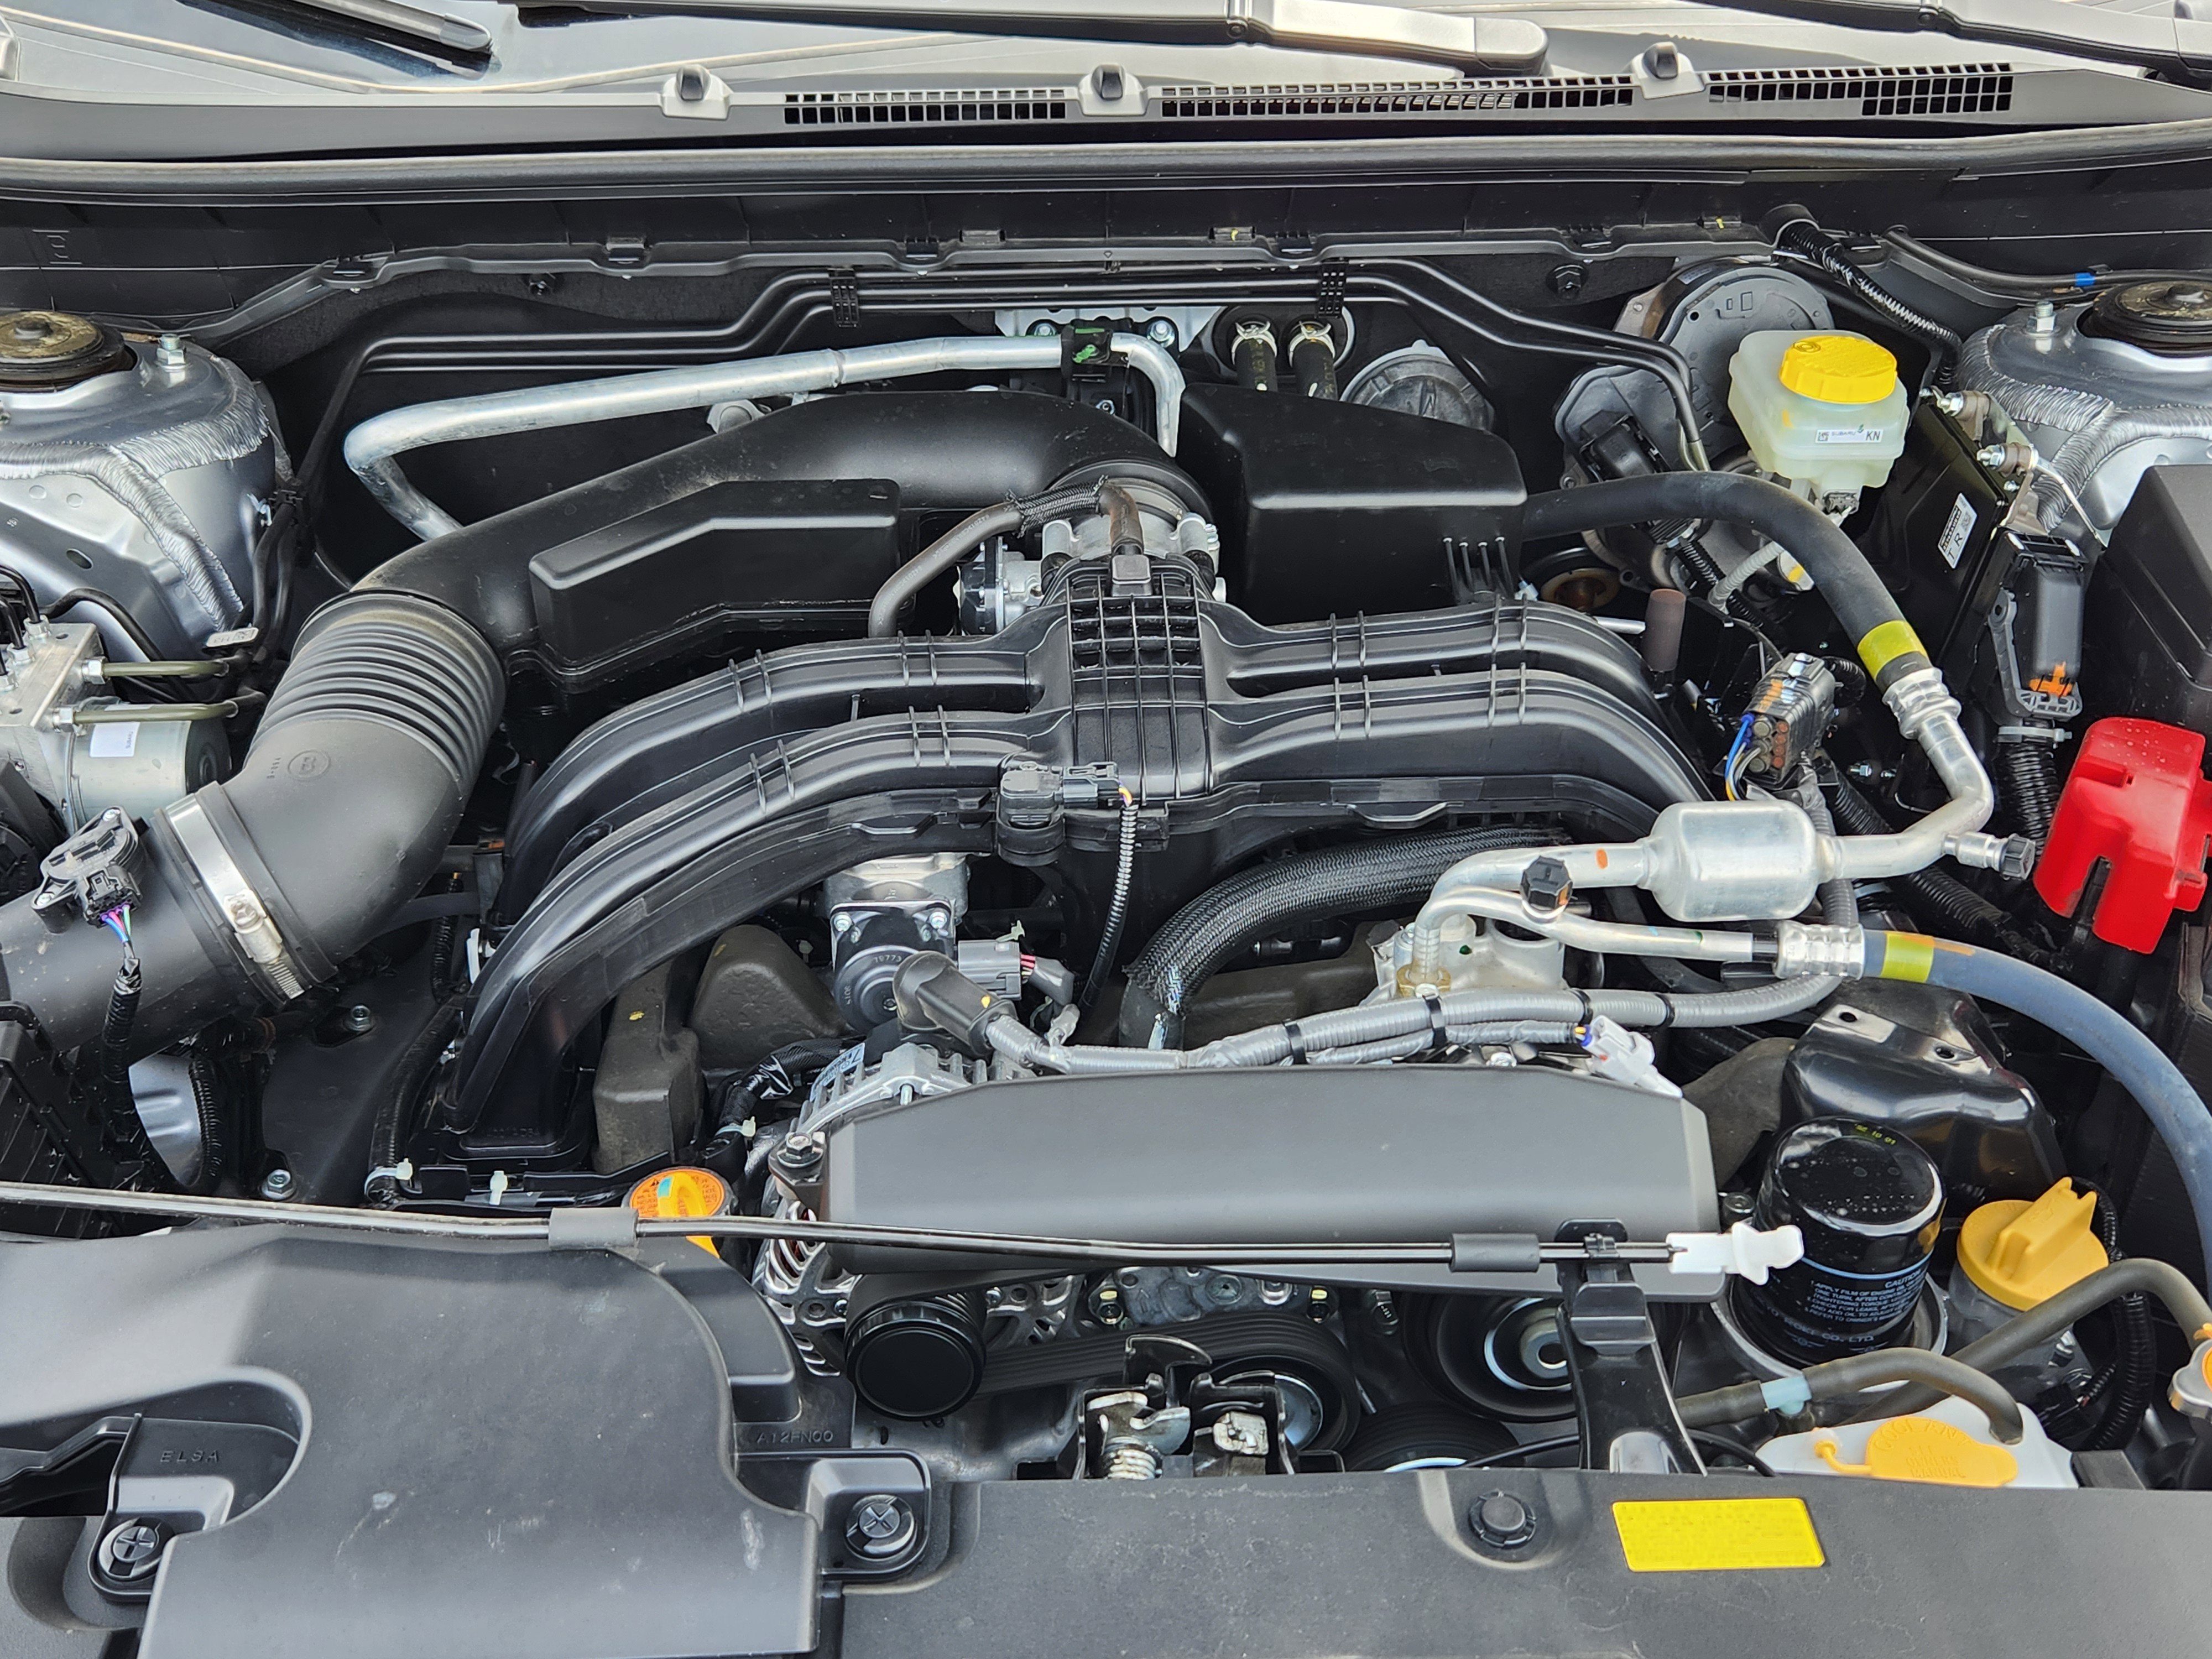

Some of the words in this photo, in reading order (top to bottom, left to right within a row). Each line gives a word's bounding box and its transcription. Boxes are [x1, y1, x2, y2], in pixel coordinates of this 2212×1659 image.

[1865, 431, 1881, 441] KN
[1814, 1282, 1840, 1293] APPLY
[160, 1449, 220, 1463] ELSA
